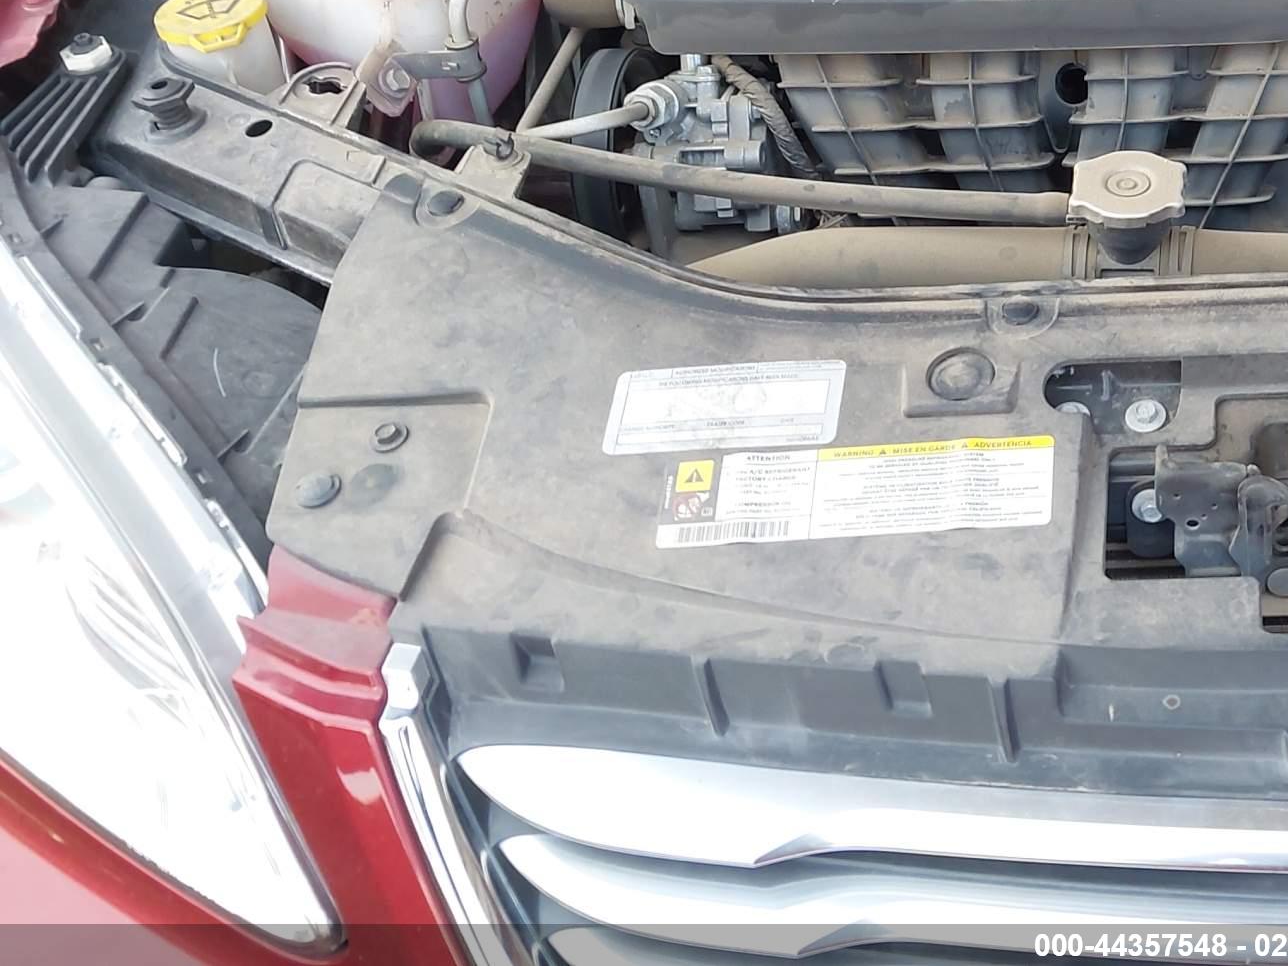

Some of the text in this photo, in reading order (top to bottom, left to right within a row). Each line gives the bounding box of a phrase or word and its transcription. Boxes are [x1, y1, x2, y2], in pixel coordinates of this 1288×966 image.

[834, 449, 875, 458] WARNING
[892, 446, 913, 454] MISE
[973, 440, 1032, 449] ADVERTENCIA
